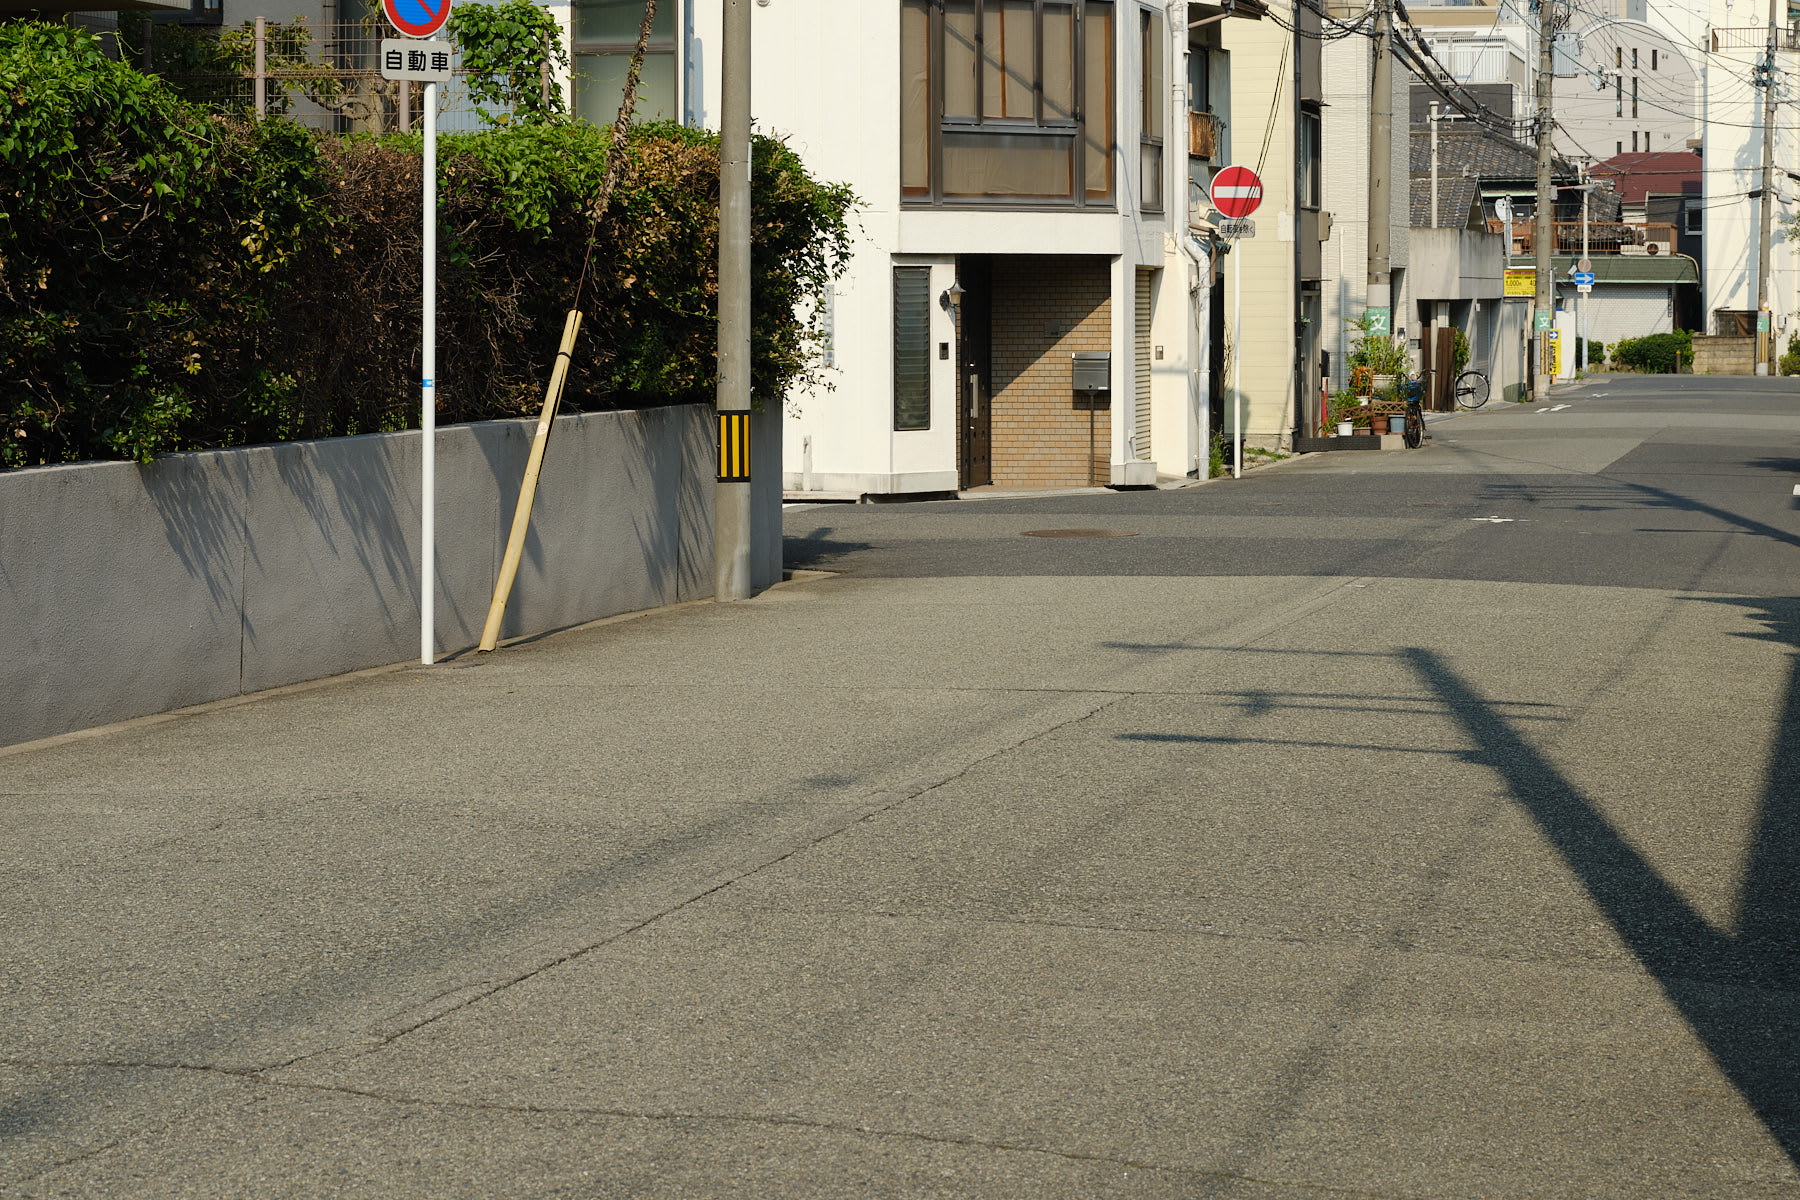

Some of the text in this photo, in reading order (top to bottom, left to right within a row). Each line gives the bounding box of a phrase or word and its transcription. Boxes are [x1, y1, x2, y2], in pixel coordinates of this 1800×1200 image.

[386, 49, 449, 72] 自動車
[1370, 314, 1386, 331] 文
